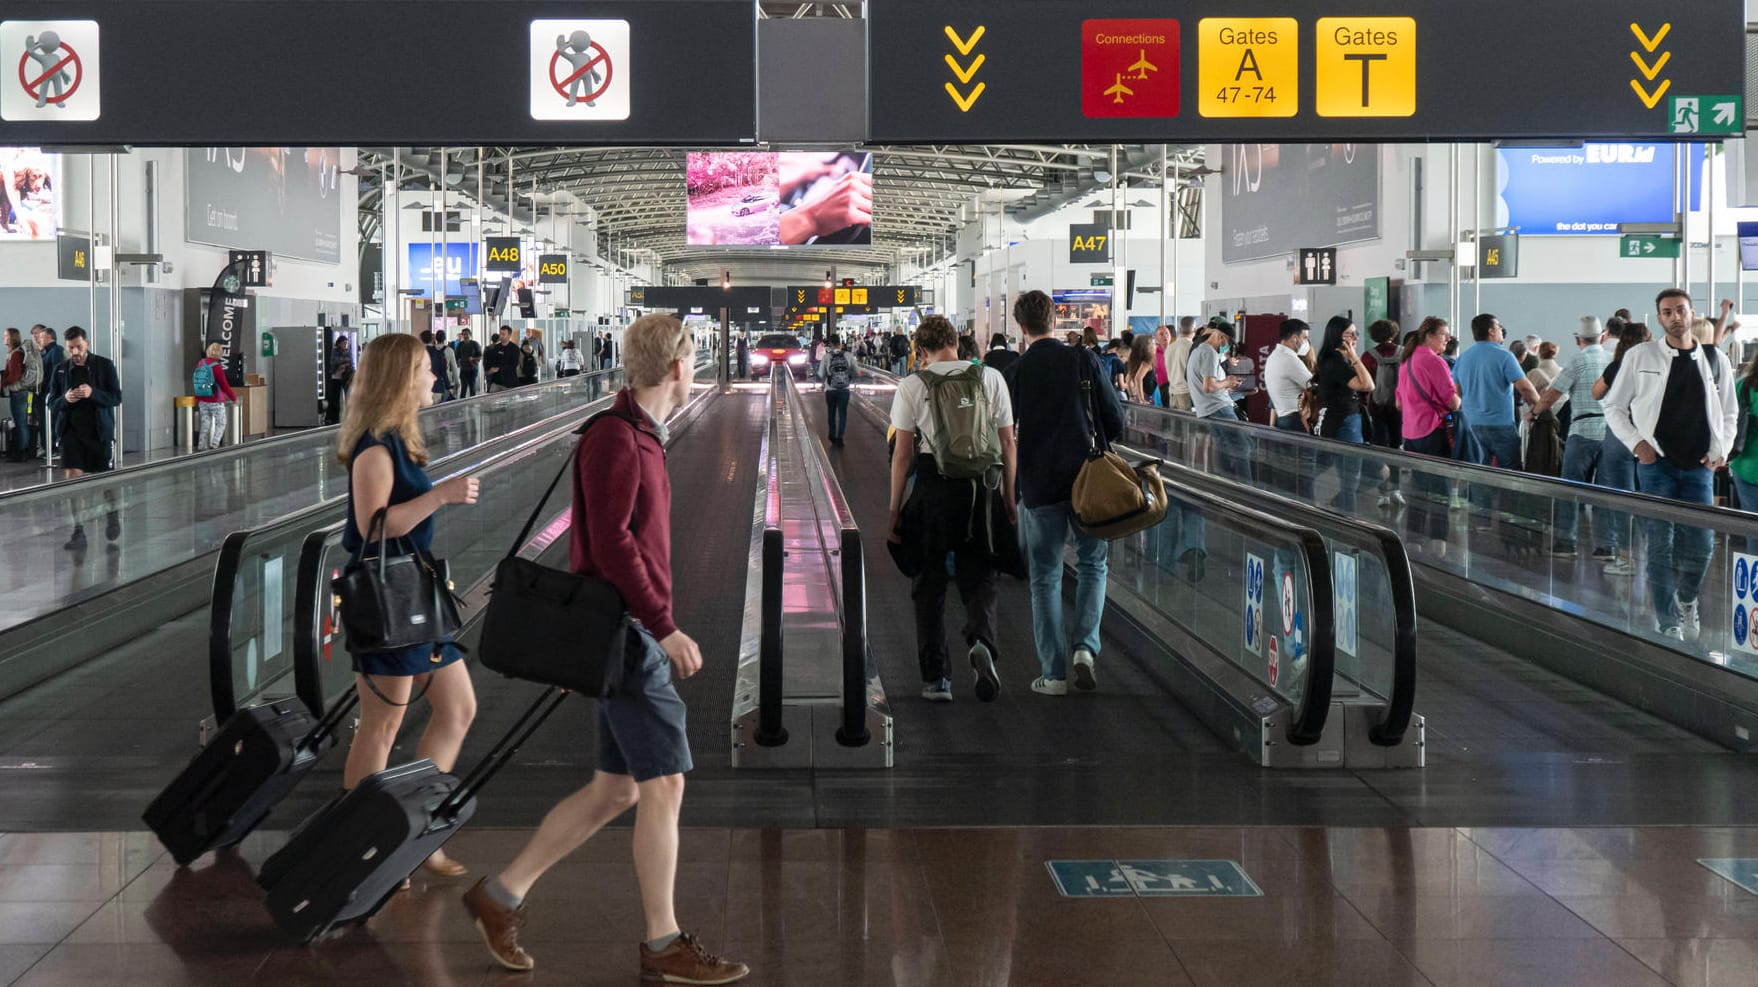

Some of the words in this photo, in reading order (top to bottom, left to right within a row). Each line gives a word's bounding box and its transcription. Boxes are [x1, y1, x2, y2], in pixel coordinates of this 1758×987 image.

[1095, 33, 1166, 45] Connections
[1219, 27, 1278, 45] Gates
[1334, 27, 1398, 46] Gates
[1235, 48, 1263, 81] A
[1344, 53, 1387, 107] T
[1531, 154, 1571, 165] Powered
[1572, 154, 1585, 166] by
[1556, 222, 1571, 231] the
[1571, 222, 1587, 231] dot
[1587, 223, 1603, 232] you
[1072, 235, 1107, 252] A47
[488, 247, 520, 262] A48
[540, 263, 566, 276] A50
[219, 296, 236, 371] WELCOME
[1258, 344, 1270, 391] COSTA
